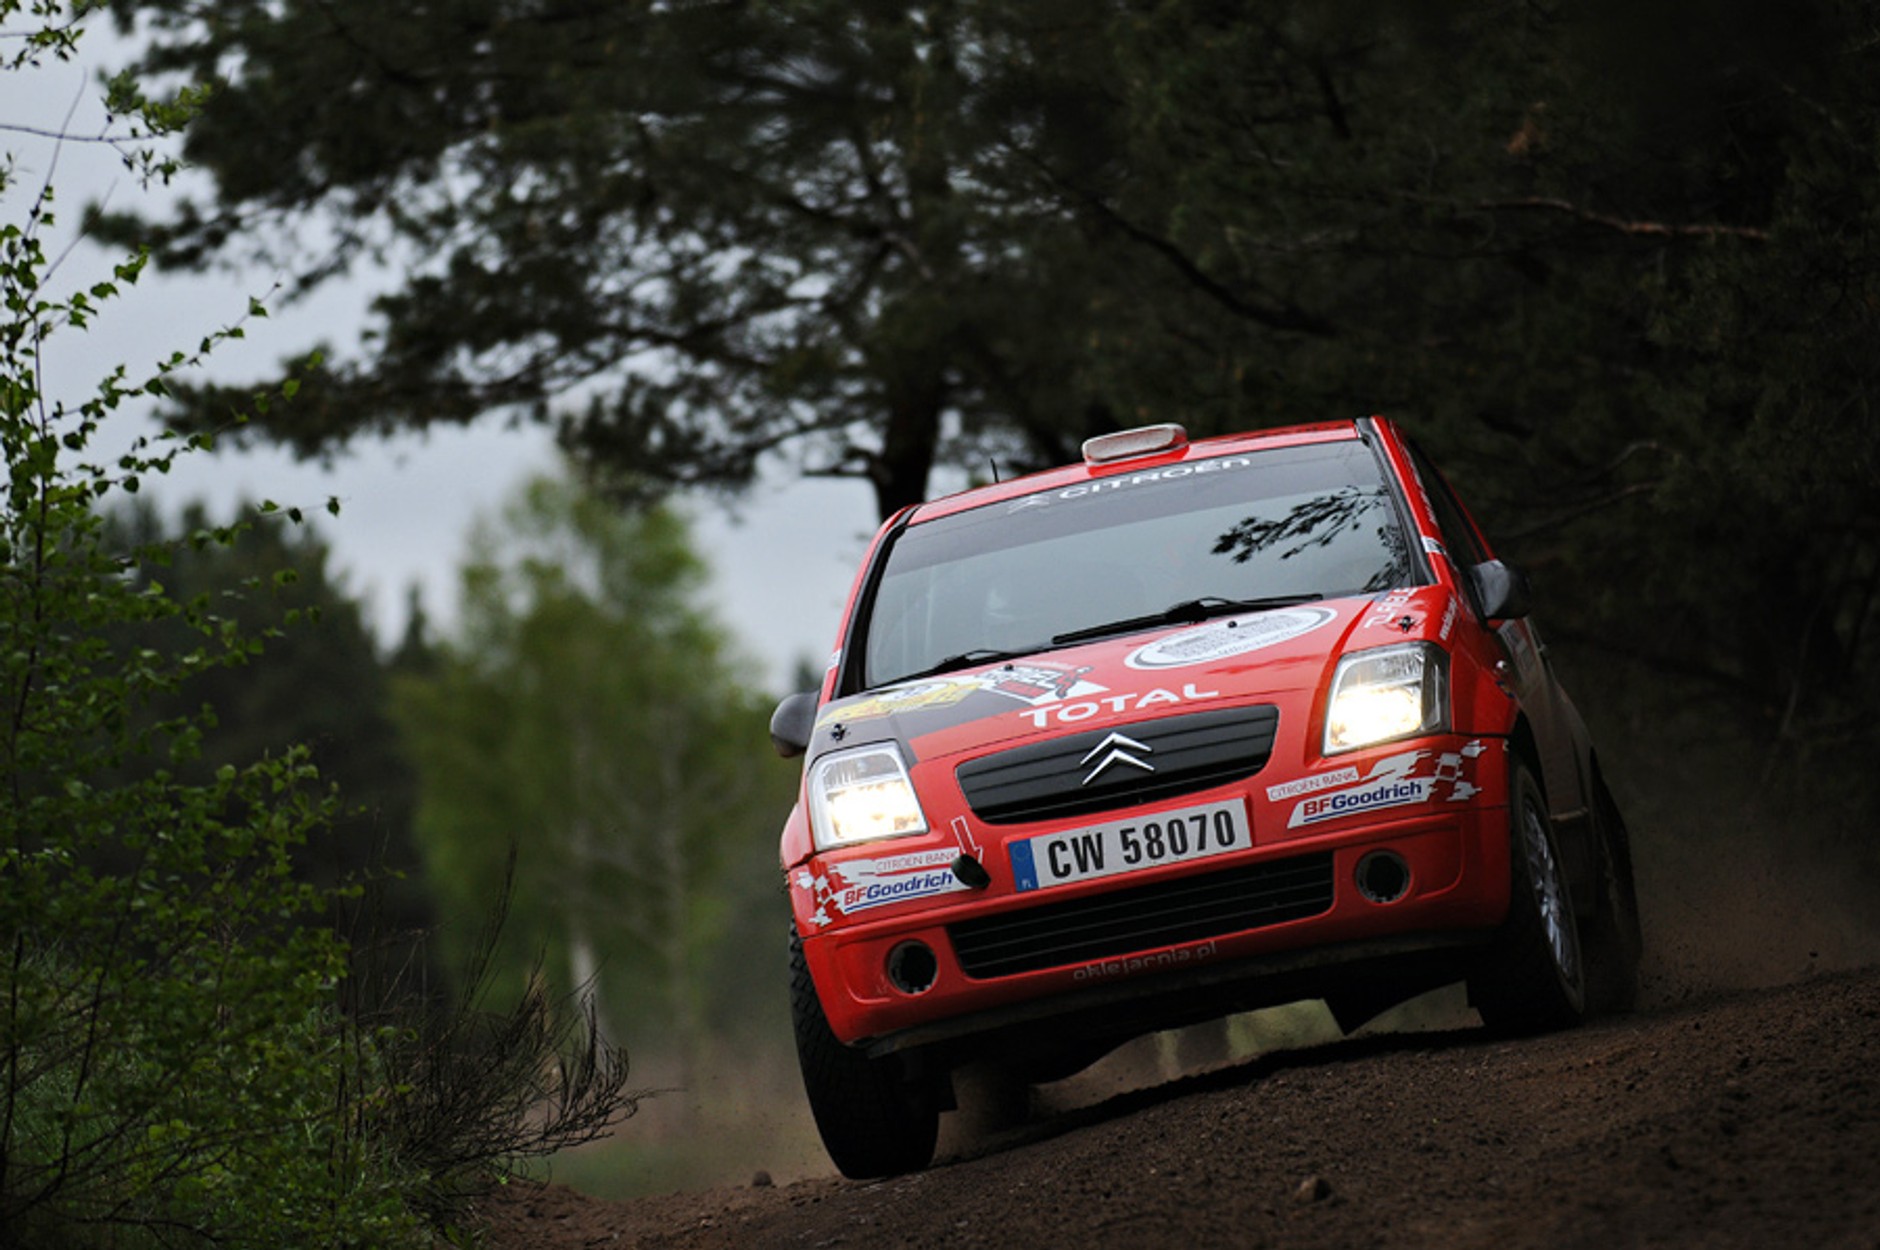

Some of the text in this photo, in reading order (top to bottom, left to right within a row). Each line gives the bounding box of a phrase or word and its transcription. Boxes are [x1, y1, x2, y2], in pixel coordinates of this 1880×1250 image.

[1019, 683, 1219, 728] TOTAL
[1321, 770, 1357, 788] BANK
[1303, 780, 1422, 816] BFGoodrich
[1048, 809, 1236, 879] CW 58070
[844, 871, 954, 906] BFGoodrich
